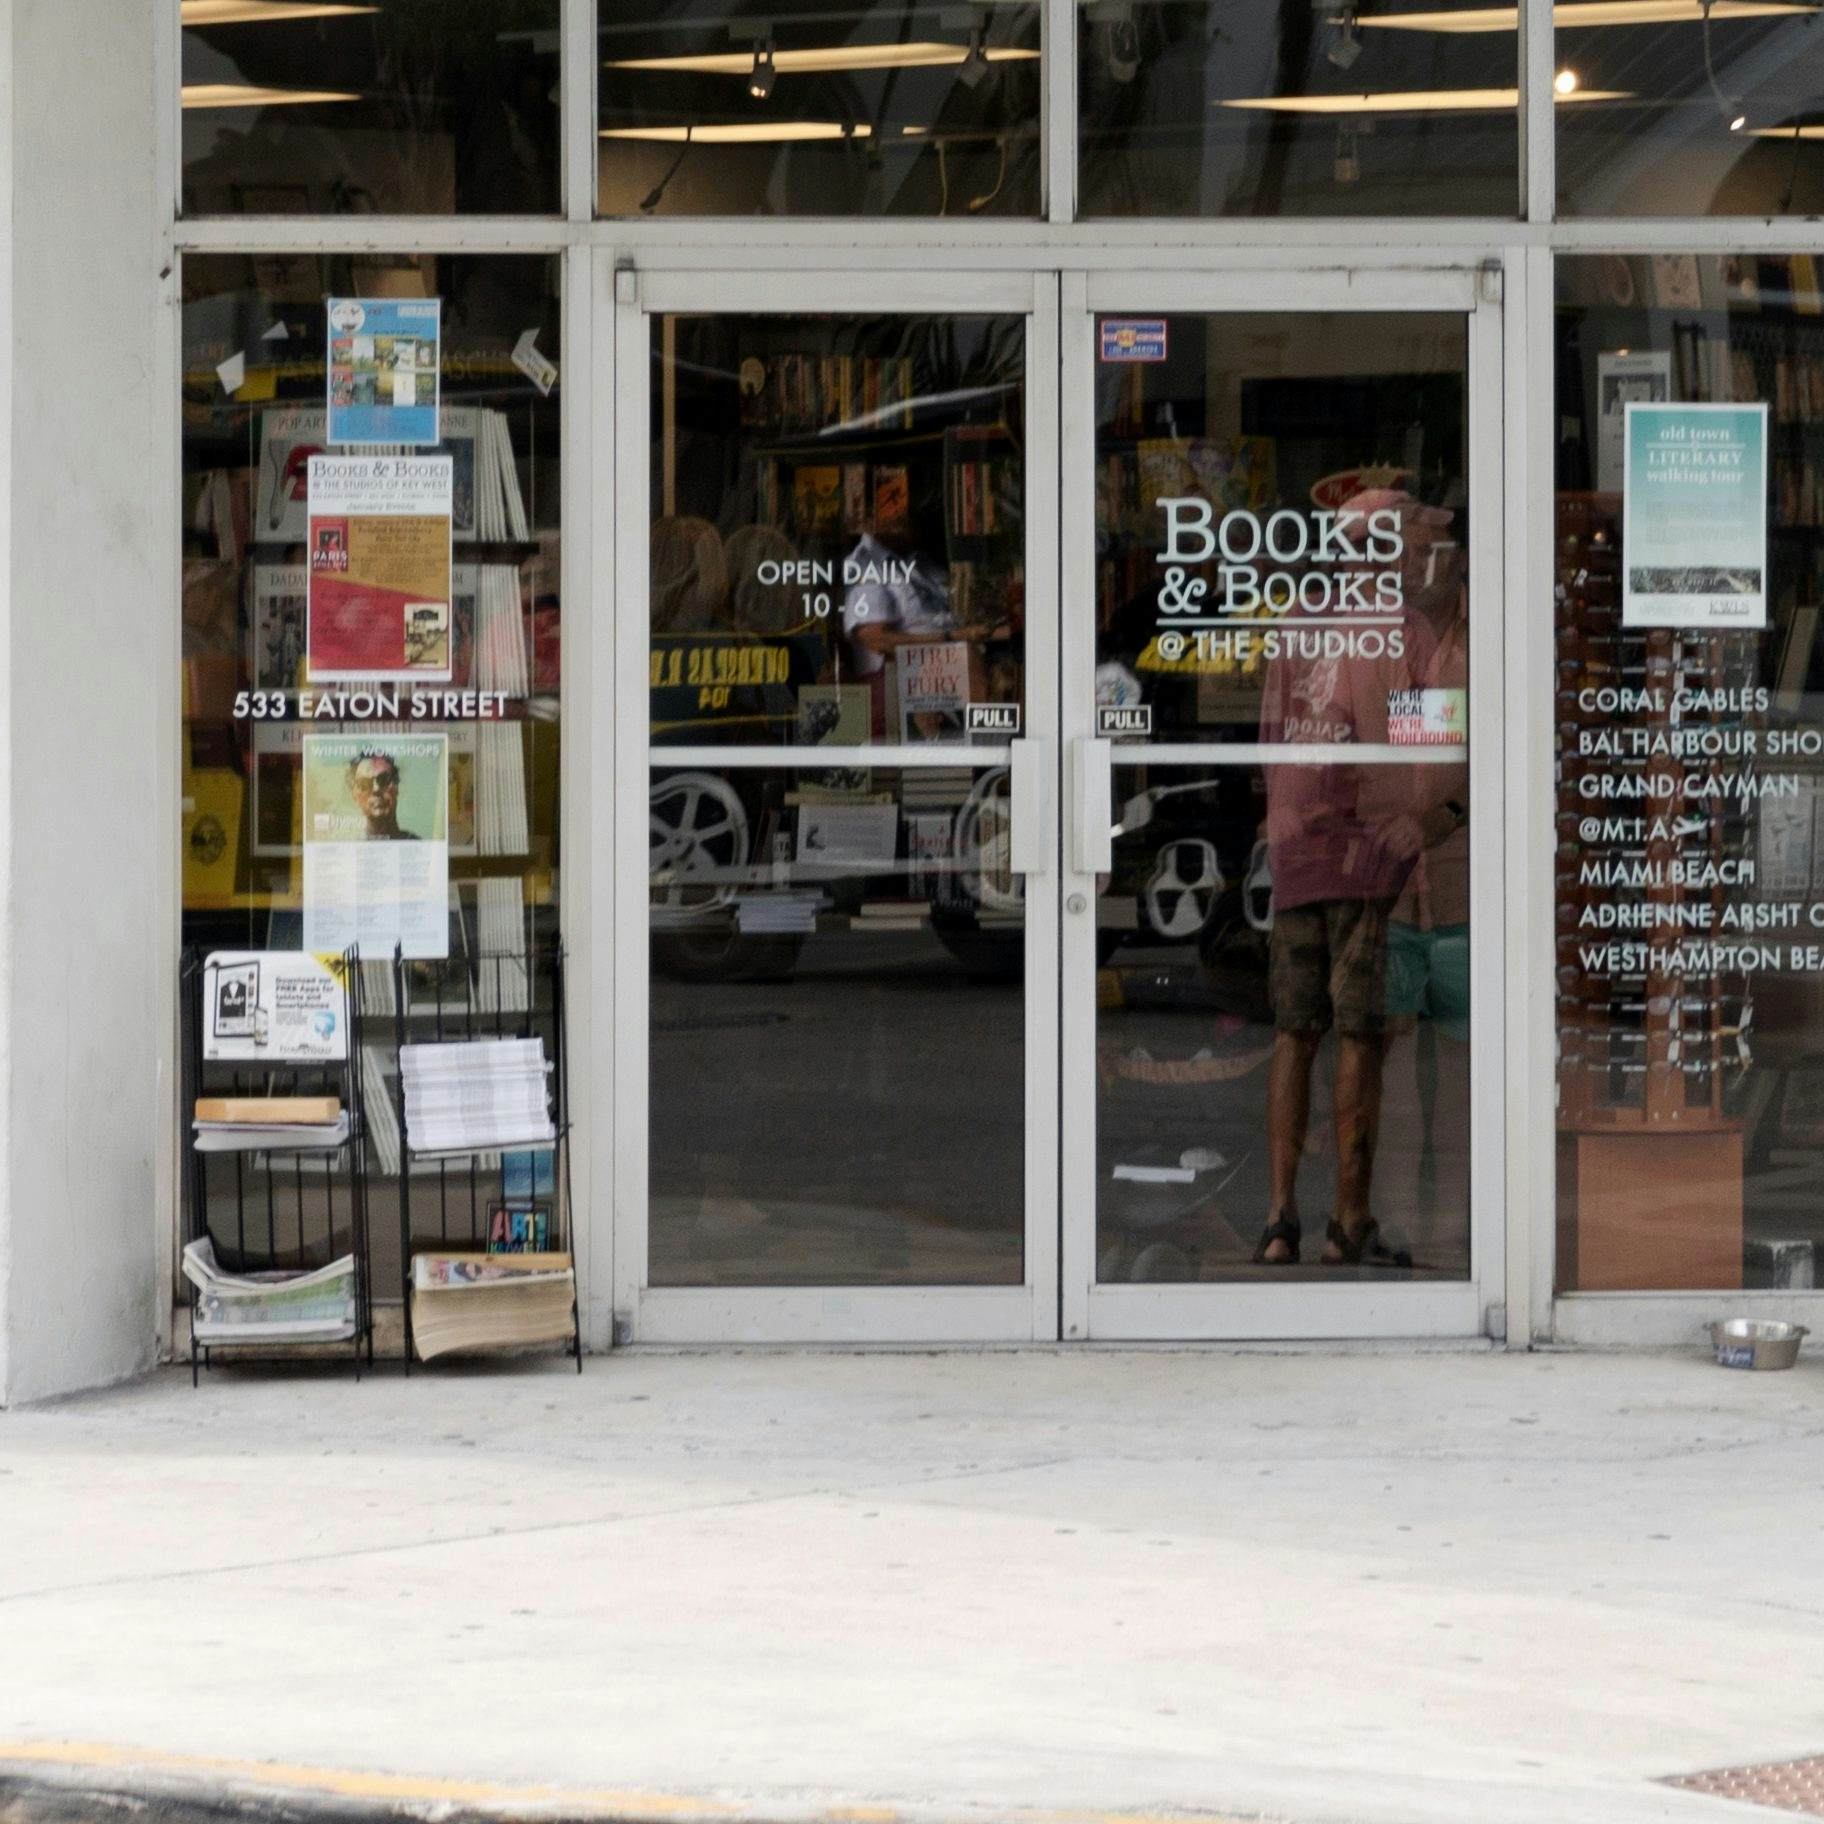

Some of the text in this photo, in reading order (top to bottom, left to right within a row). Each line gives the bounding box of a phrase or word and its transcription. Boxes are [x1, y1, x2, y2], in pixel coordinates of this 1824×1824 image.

[1660, 425, 1730, 441] old town
[372, 460, 390, 477] &
[1649, 451, 1742, 465] LITERARY
[325, 480, 340, 490] THE
[343, 479, 384, 490] STUDIOS
[386, 480, 398, 490] OF
[402, 480, 420, 490] KEY
[423, 480, 448, 490] WEST
[1646, 468, 1744, 485] walking tour
[1155, 497, 1404, 564] BOOKS
[757, 560, 917, 586] OPEN DAILY
[1156, 564, 1404, 614] & BOOKS
[801, 593, 830, 619] 10
[854, 592, 870, 619] 6
[907, 647, 958, 665] FIRE
[1156, 629, 1405, 660] @ THE STUDIOS
[907, 675, 959, 694] FURY
[232, 690, 510, 719] 533 EATON STREET
[1387, 705, 1423, 716] LOCAL
[1579, 687, 1770, 712] CORAL GABLES
[973, 709, 1014, 727] PULL
[1104, 712, 1145, 729] PULL
[312, 744, 440, 758] WINTER WORKSHOPS
[1579, 731, 1624, 756] BAL
[1633, 731, 1757, 756] HARBOUR
[1579, 774, 1800, 798] GRAND CAYMAN
[1579, 860, 1756, 885] MIAMI BEACH
[1578, 903, 1714, 928] ADRIENNE
[1720, 903, 1803, 928] ARSHT
[1578, 946, 1781, 971] WESTHAMPTON
